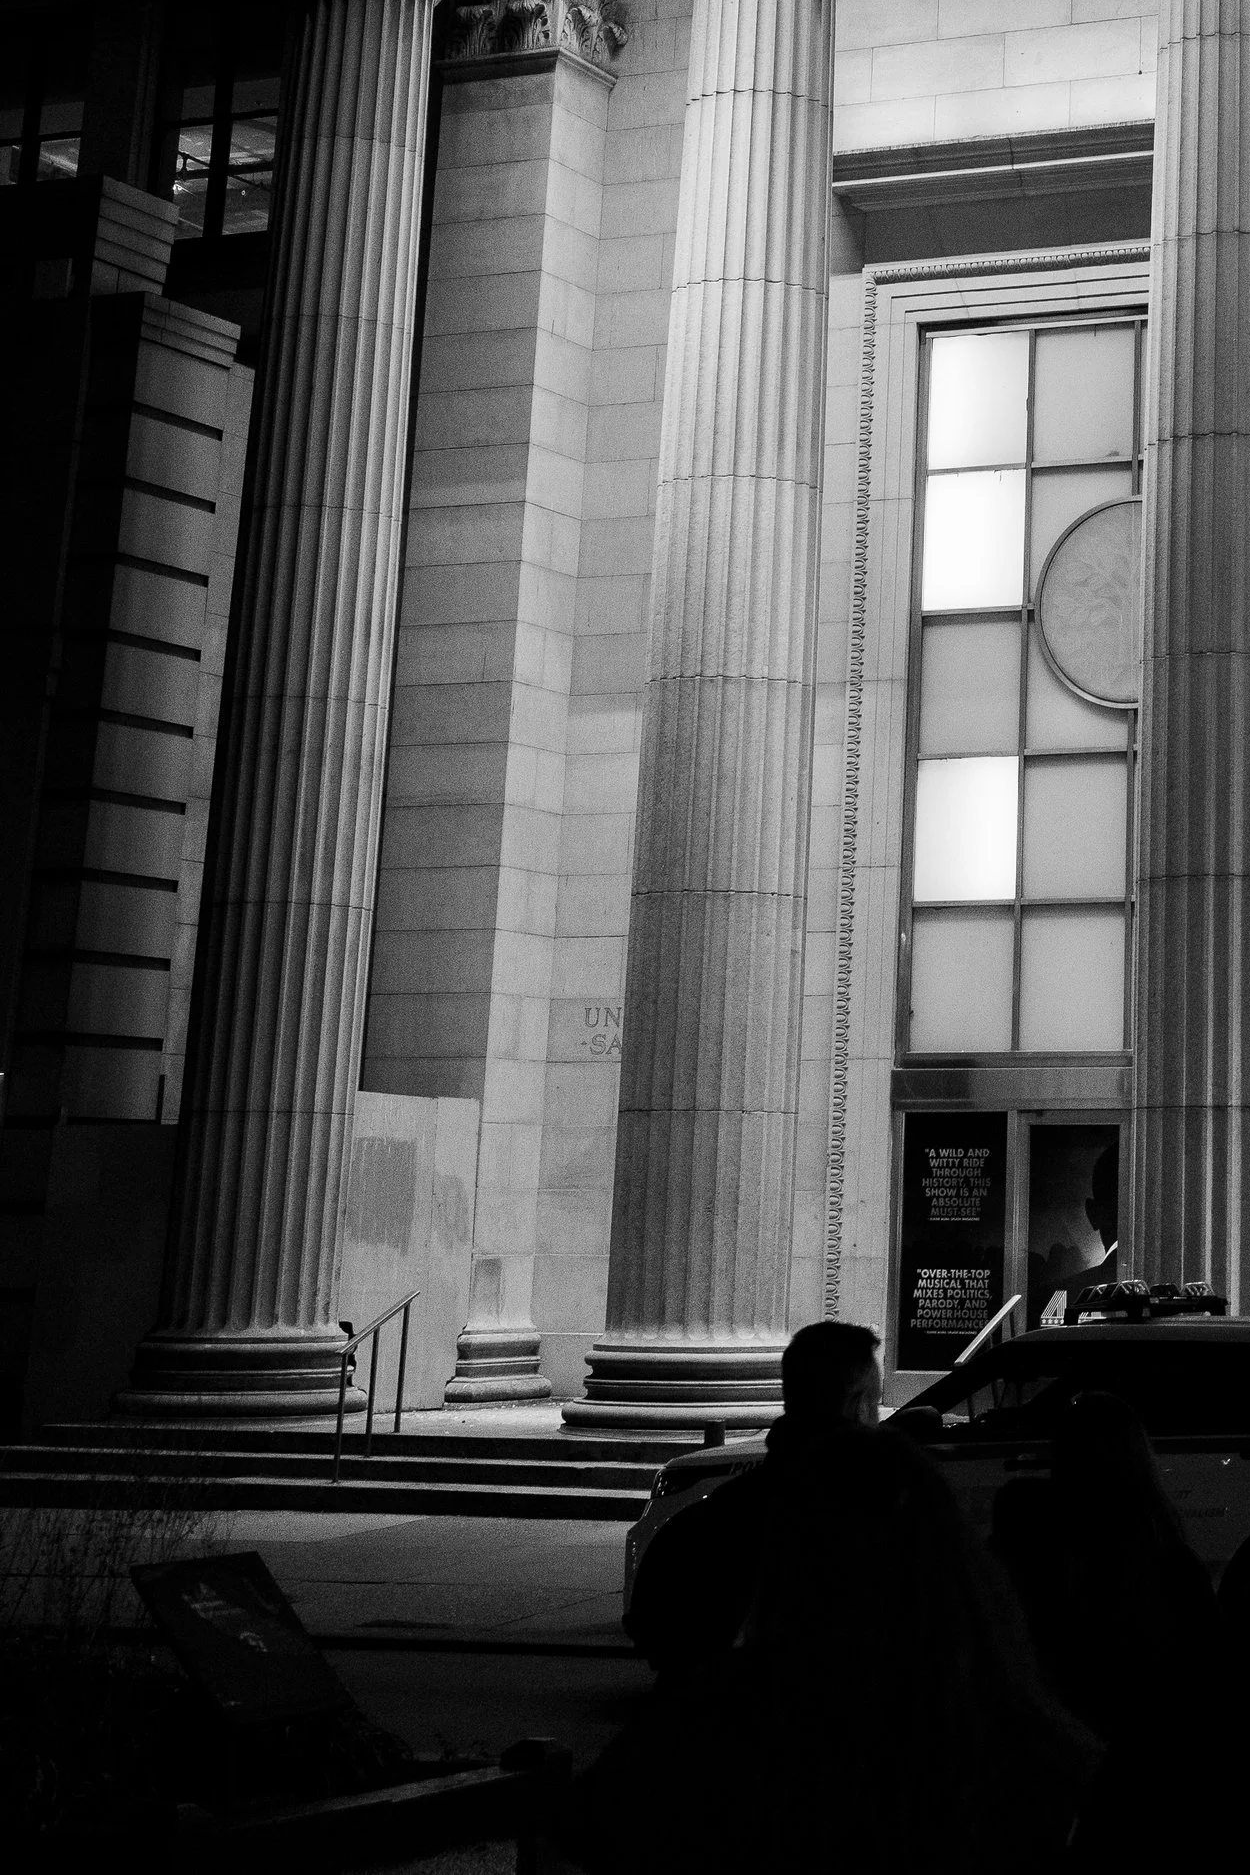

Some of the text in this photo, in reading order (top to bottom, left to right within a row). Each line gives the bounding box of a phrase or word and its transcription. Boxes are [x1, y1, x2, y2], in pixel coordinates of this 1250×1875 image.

[584, 1007, 623, 1028] UN
[939, 1148, 965, 1157] WILD
[967, 1148, 990, 1157] AND
[929, 1158, 985, 1167] WITTY RIDE
[931, 1168, 981, 1177] THROUGH
[921, 1178, 991, 1187] HISTORY, THIS
[925, 1188, 987, 1197] SHOW IS AN
[931, 1197, 981, 1206] ABSOLUTE
[917, 1279, 989, 1288] MUSICAL THAT
[913, 1289, 993, 1300] MIXES POLITICS,
[918, 1299, 987, 1309] PARODY, AND
[916, 1309, 988, 1319] POWERHOUSE
